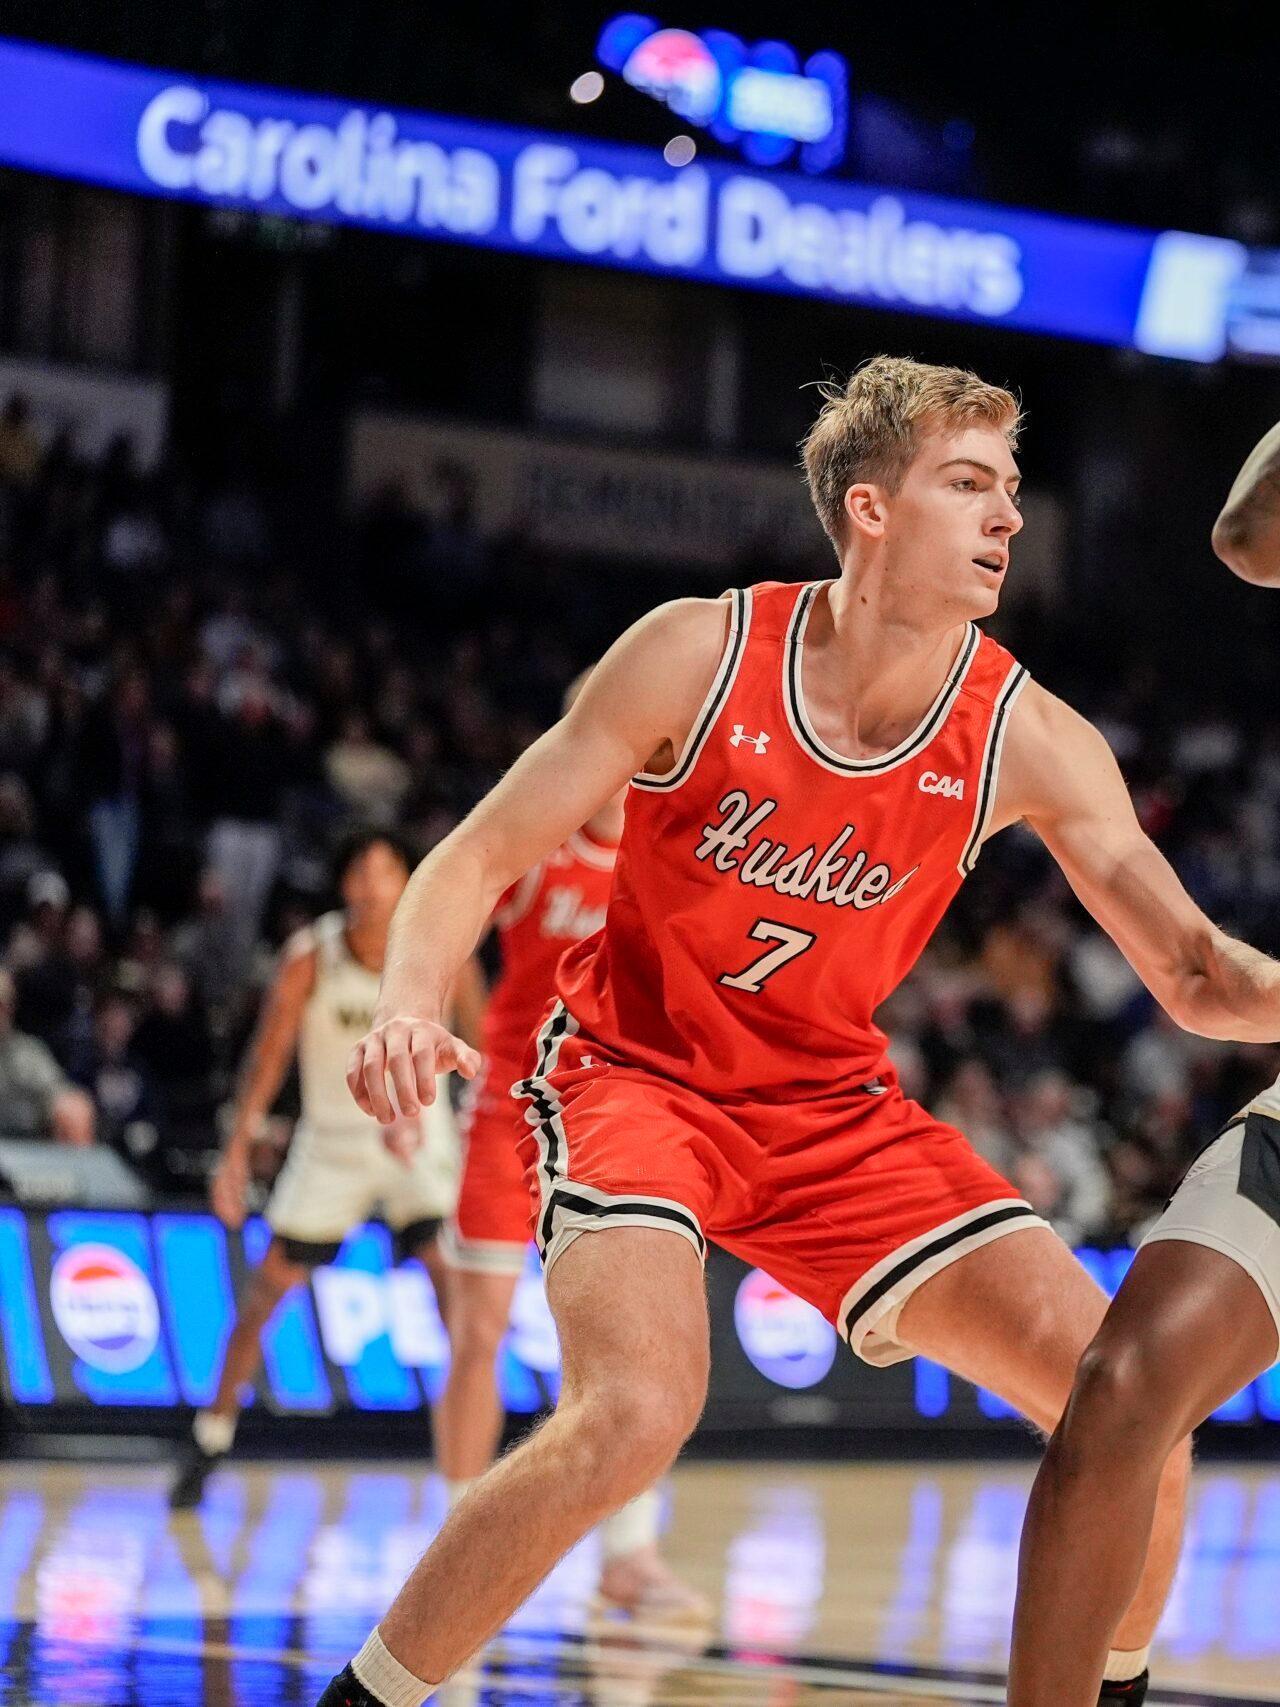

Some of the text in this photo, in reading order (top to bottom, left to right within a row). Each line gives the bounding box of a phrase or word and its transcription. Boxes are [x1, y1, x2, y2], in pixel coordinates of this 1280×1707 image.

[137, 86, 1022, 316] Carolina Ford Dealers
[918, 771, 965, 800] CAA
[717, 916, 818, 994] 7
